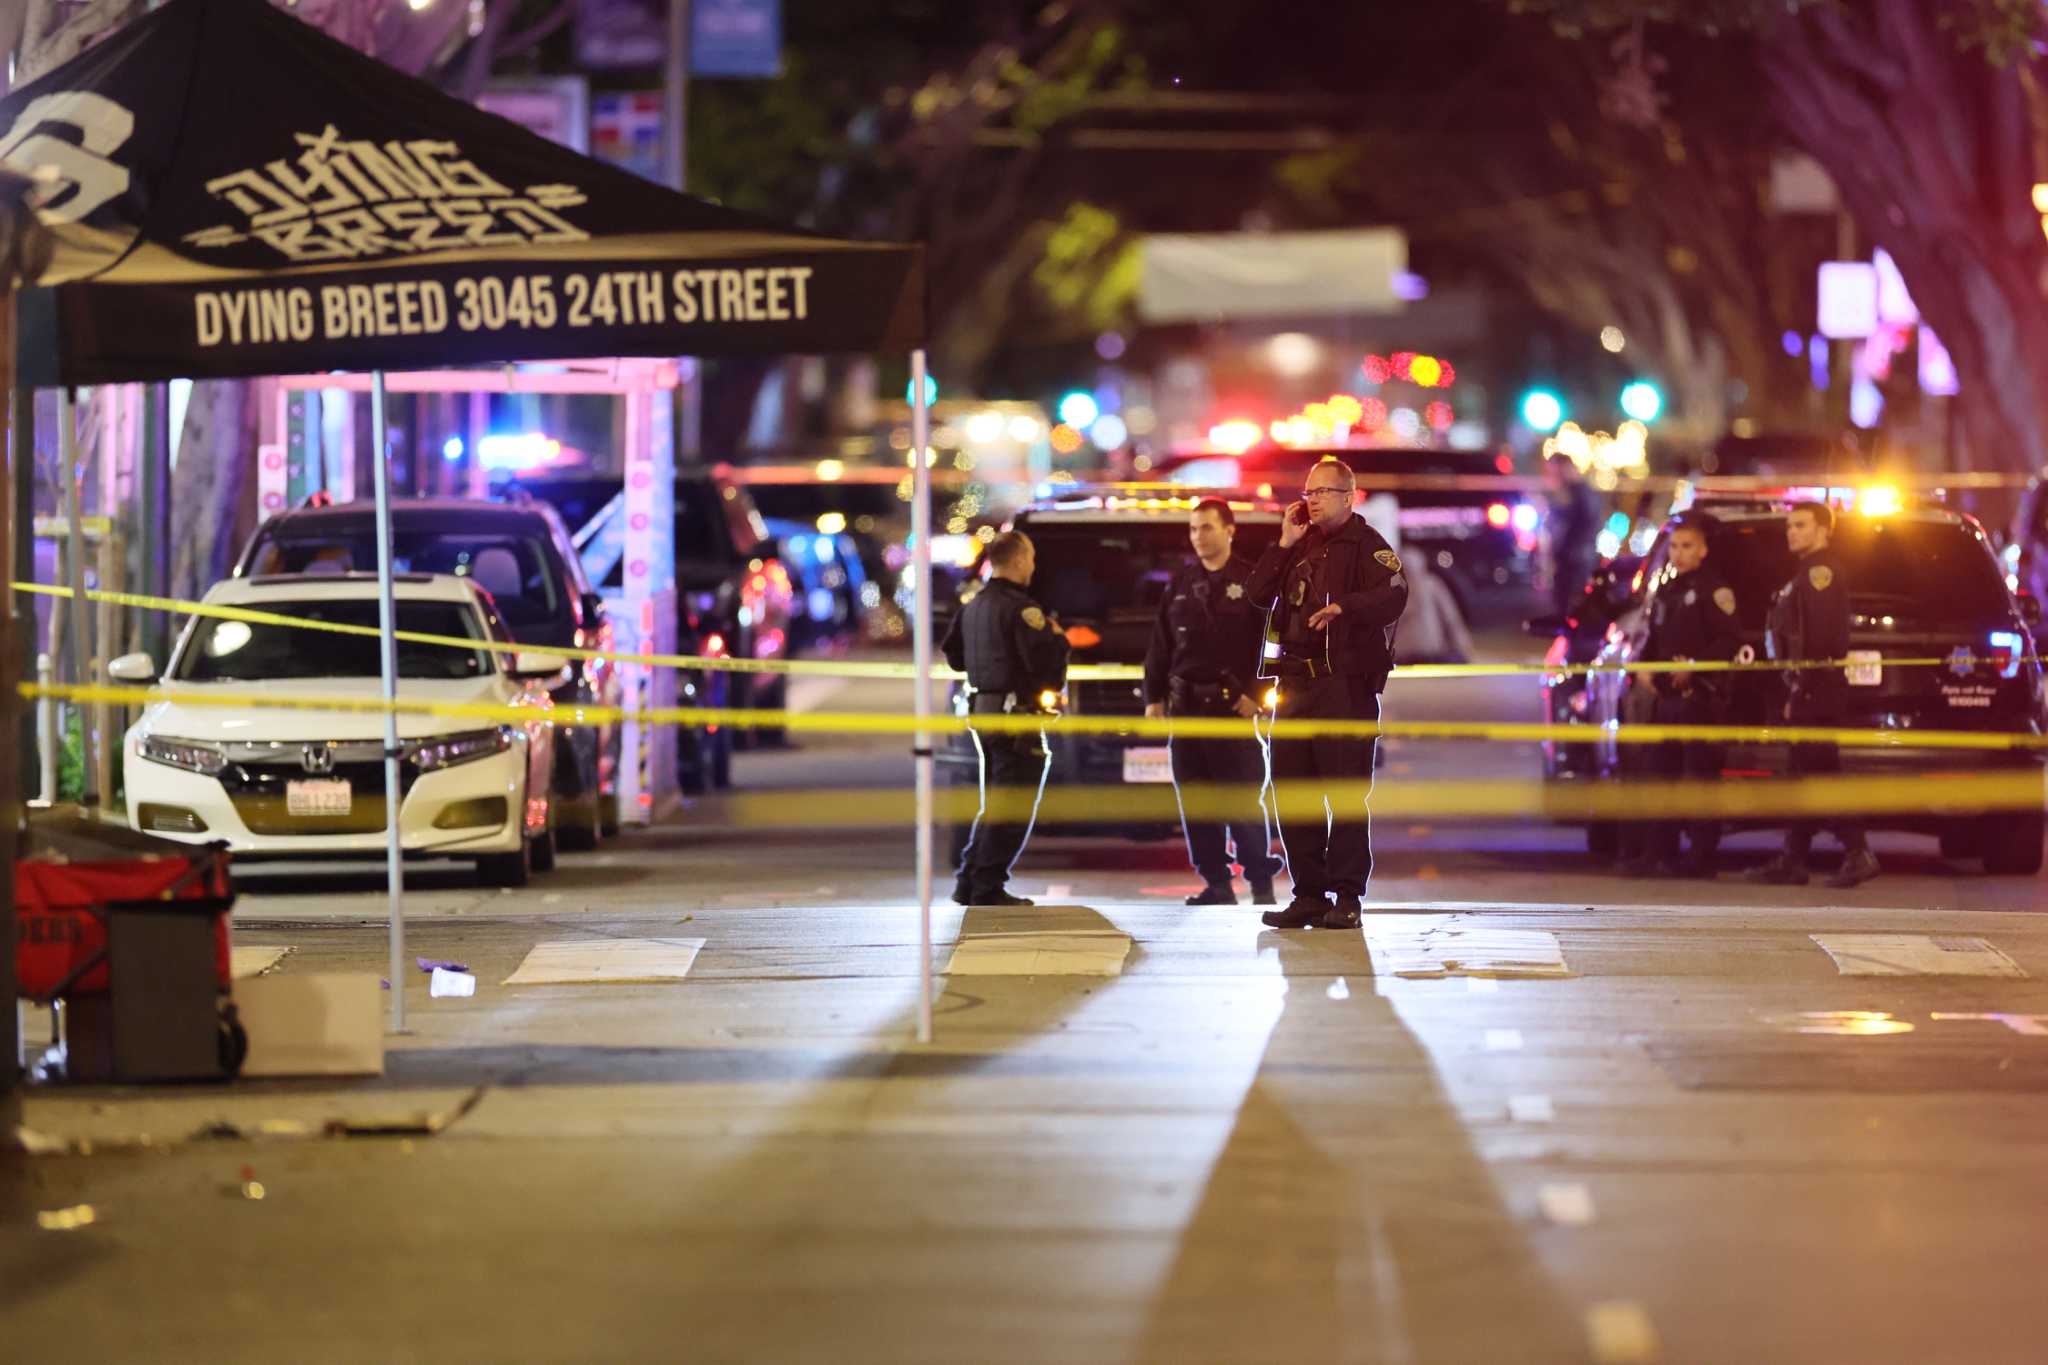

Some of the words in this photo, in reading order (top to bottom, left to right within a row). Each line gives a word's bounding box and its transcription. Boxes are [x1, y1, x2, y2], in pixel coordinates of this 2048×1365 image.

[206, 123, 514, 228] DYING
[250, 198, 592, 261] BREED
[195, 287, 314, 346] DYING
[321, 280, 448, 339] BREED
[454, 276, 557, 332] 3045
[564, 273, 666, 326] 24TH
[672, 267, 812, 323] STREET
